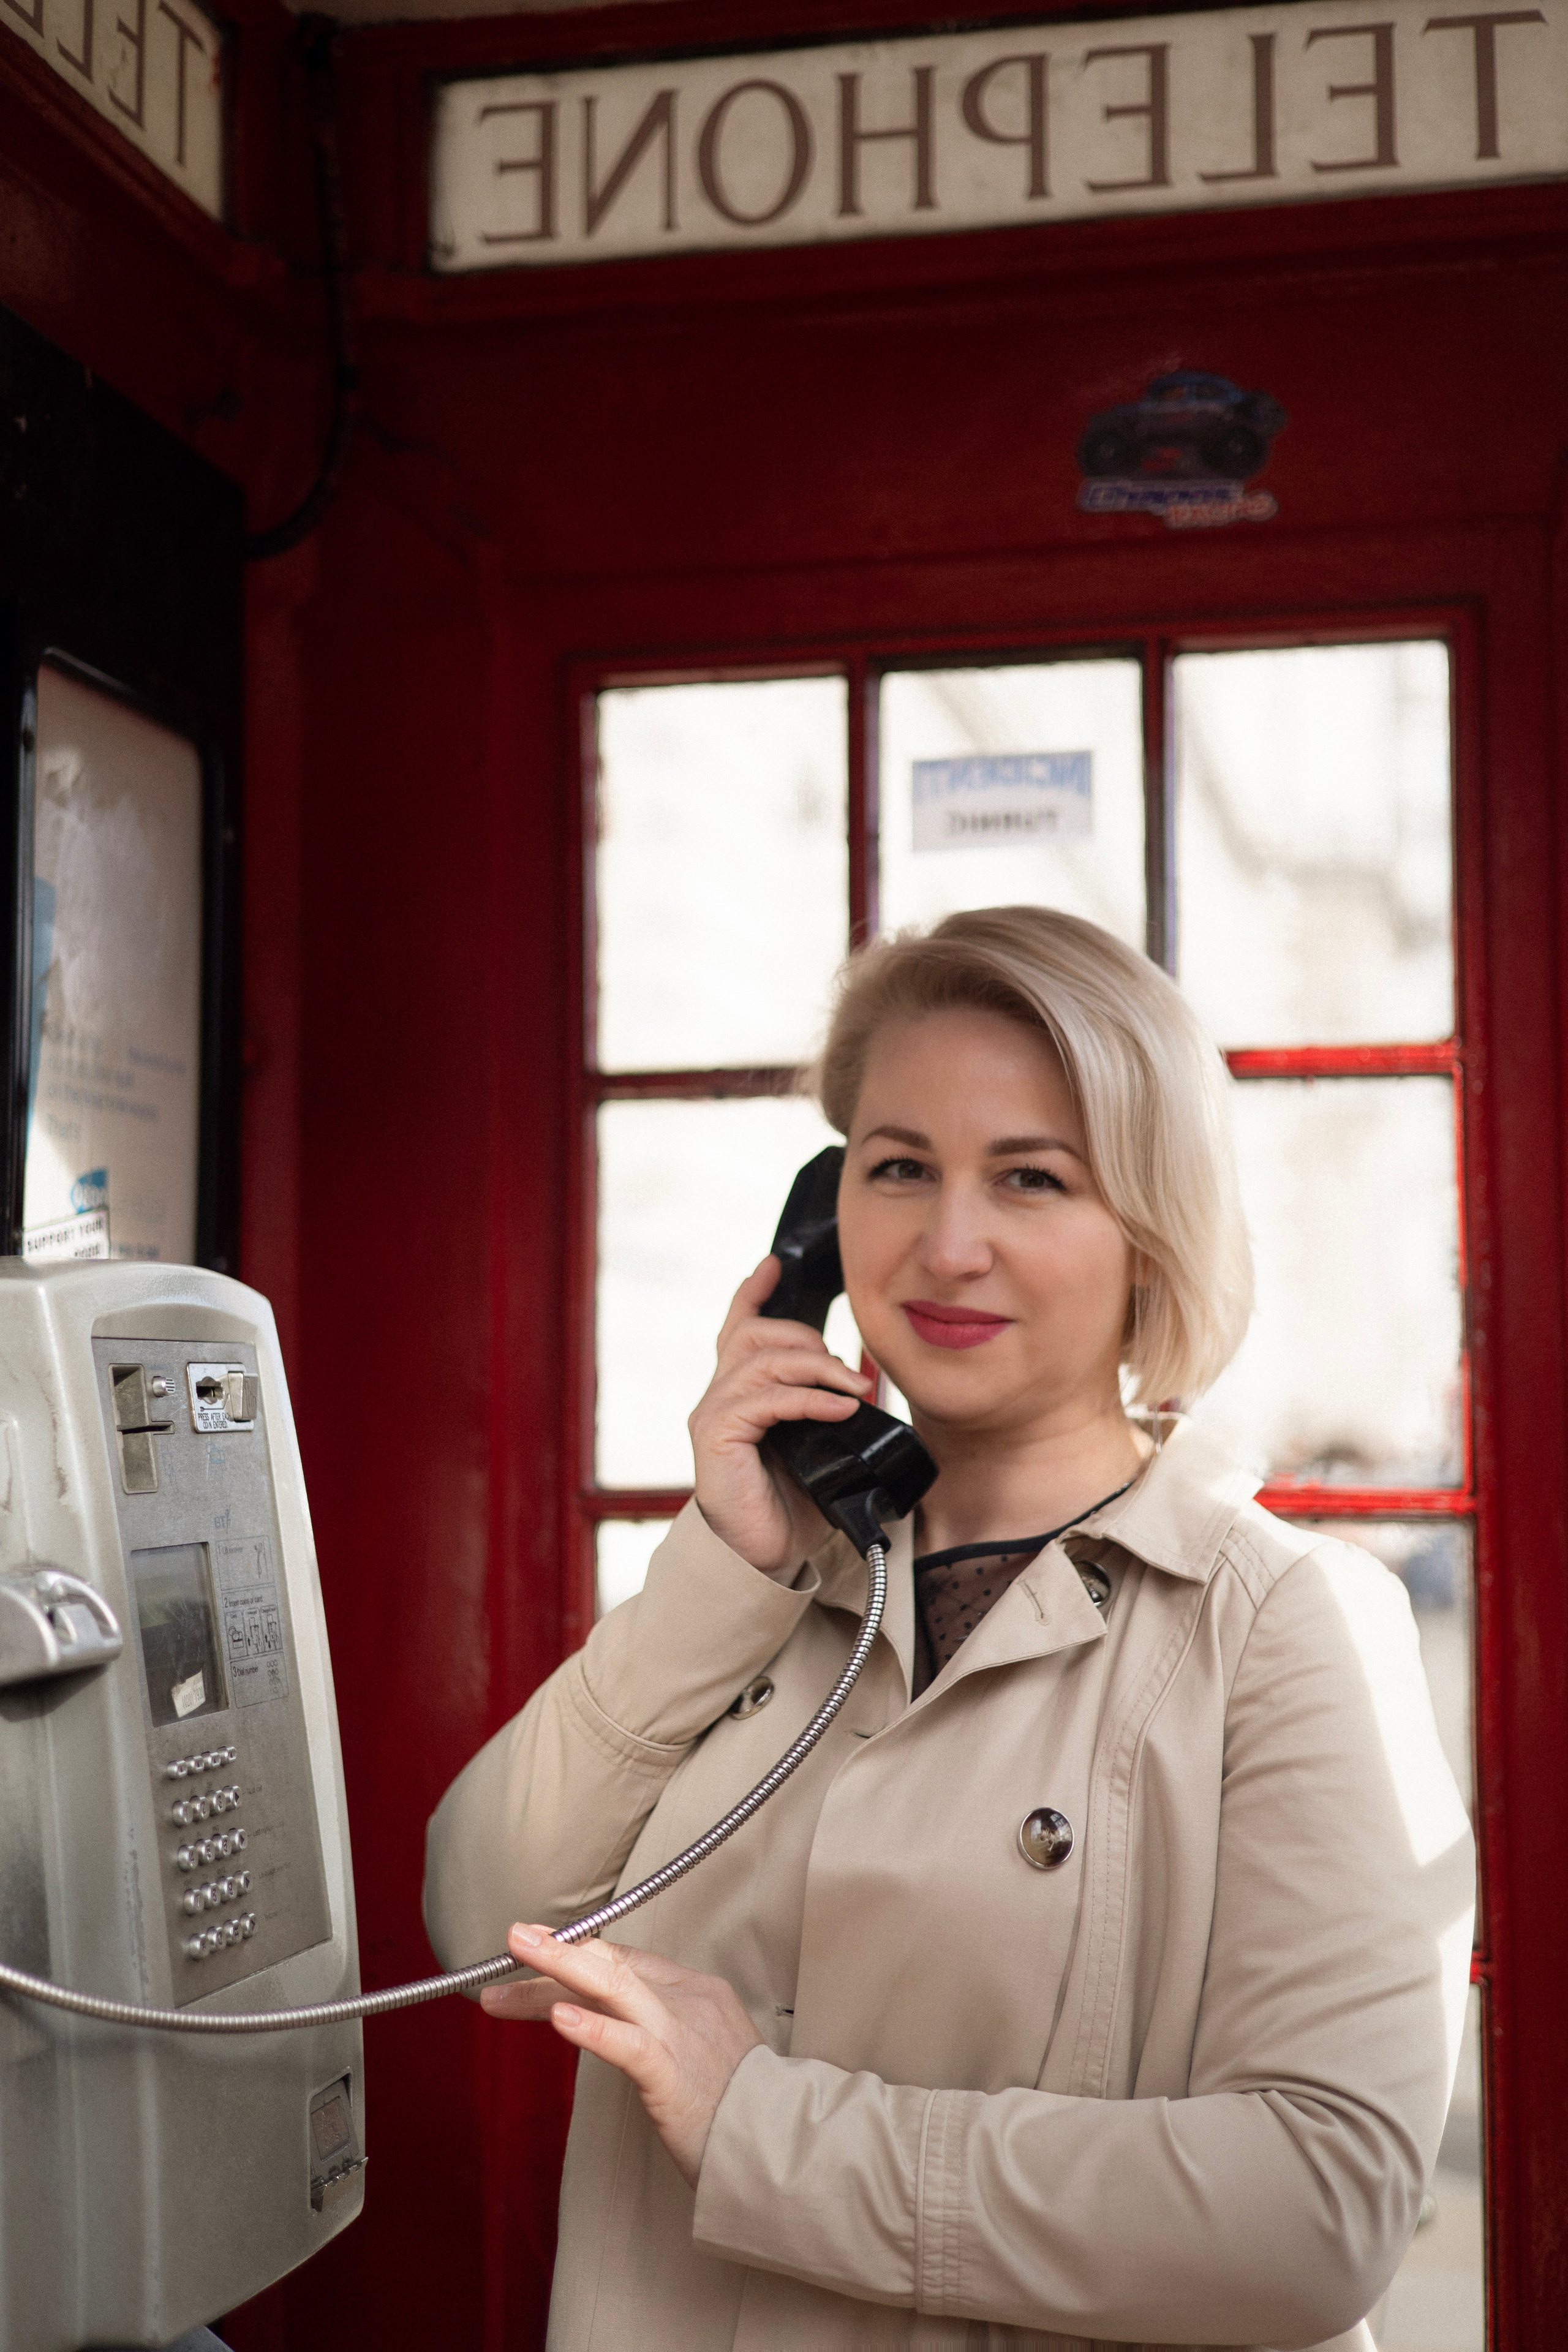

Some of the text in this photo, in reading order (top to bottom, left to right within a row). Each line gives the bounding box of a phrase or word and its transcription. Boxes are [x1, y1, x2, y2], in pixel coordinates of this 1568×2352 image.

[198, 1412, 209, 1422] PRESS
[211, 1412, 221, 1421] AFTER
[203, 1421, 213, 1430] COIN
[224, 1597, 228, 1608] 2
[229, 1599, 239, 1607] Insert
[233, 1666, 237, 1677] 3
[245, 1666, 258, 1675] number
